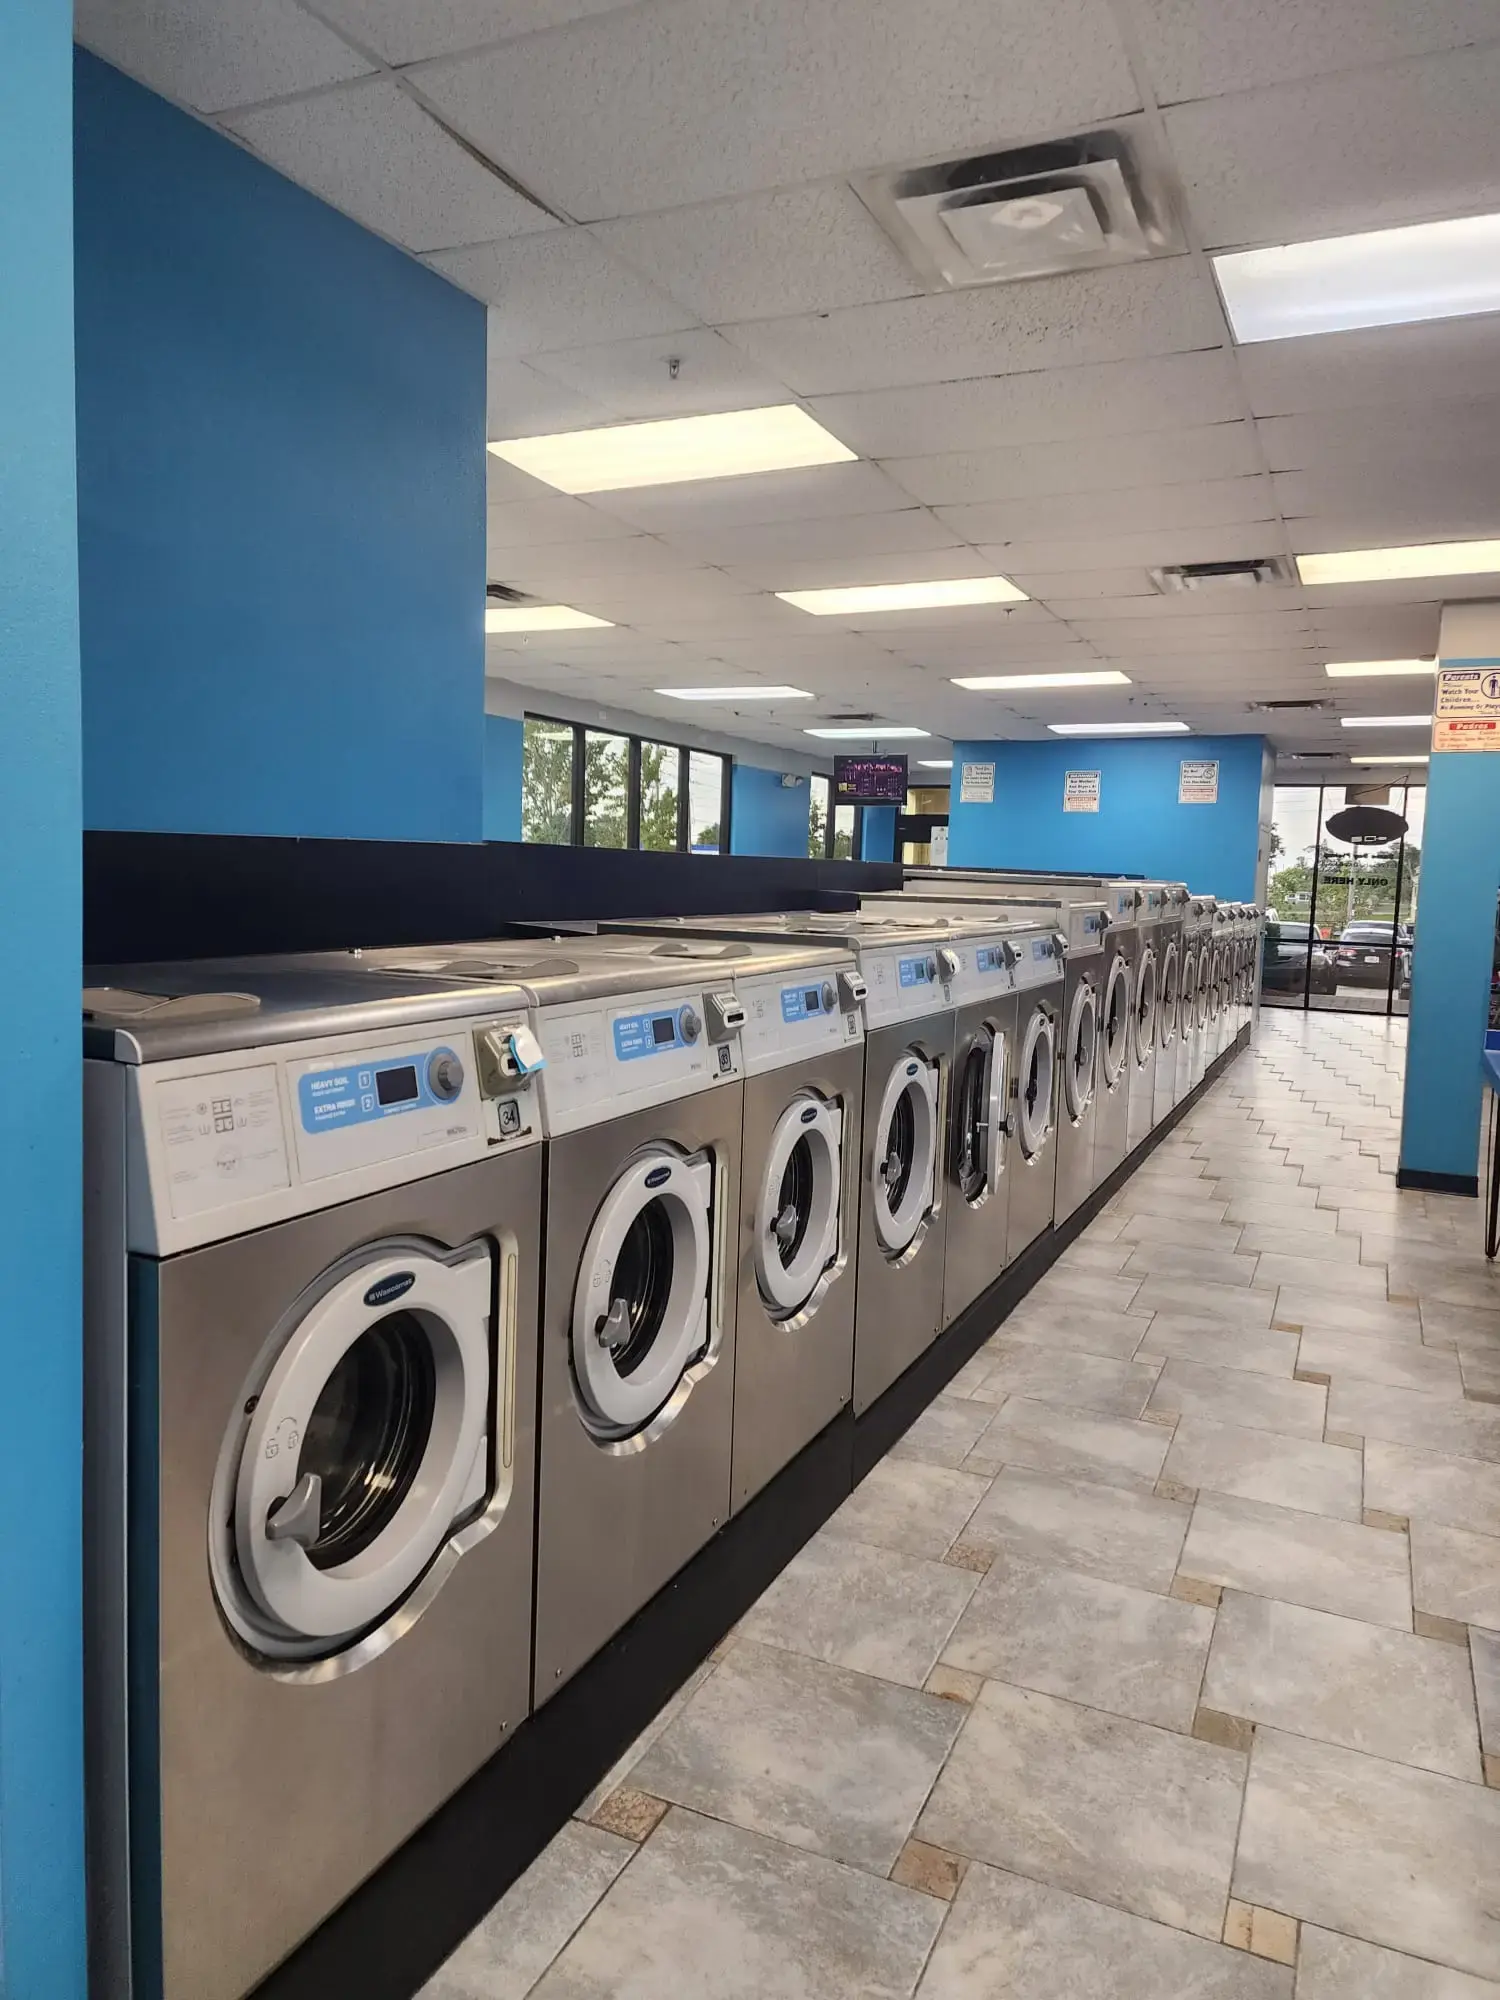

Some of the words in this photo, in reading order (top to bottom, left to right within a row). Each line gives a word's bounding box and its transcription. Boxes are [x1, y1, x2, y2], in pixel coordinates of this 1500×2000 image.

[1445, 673, 1479, 681] Parents
[311, 1079, 334, 1092] HEAVY
[334, 1076, 350, 1087] SOIL
[314, 1102, 337, 1115] EXTRA
[503, 1110, 515, 1126] 34
[375, 1278, 412, 1299] Wascomat
